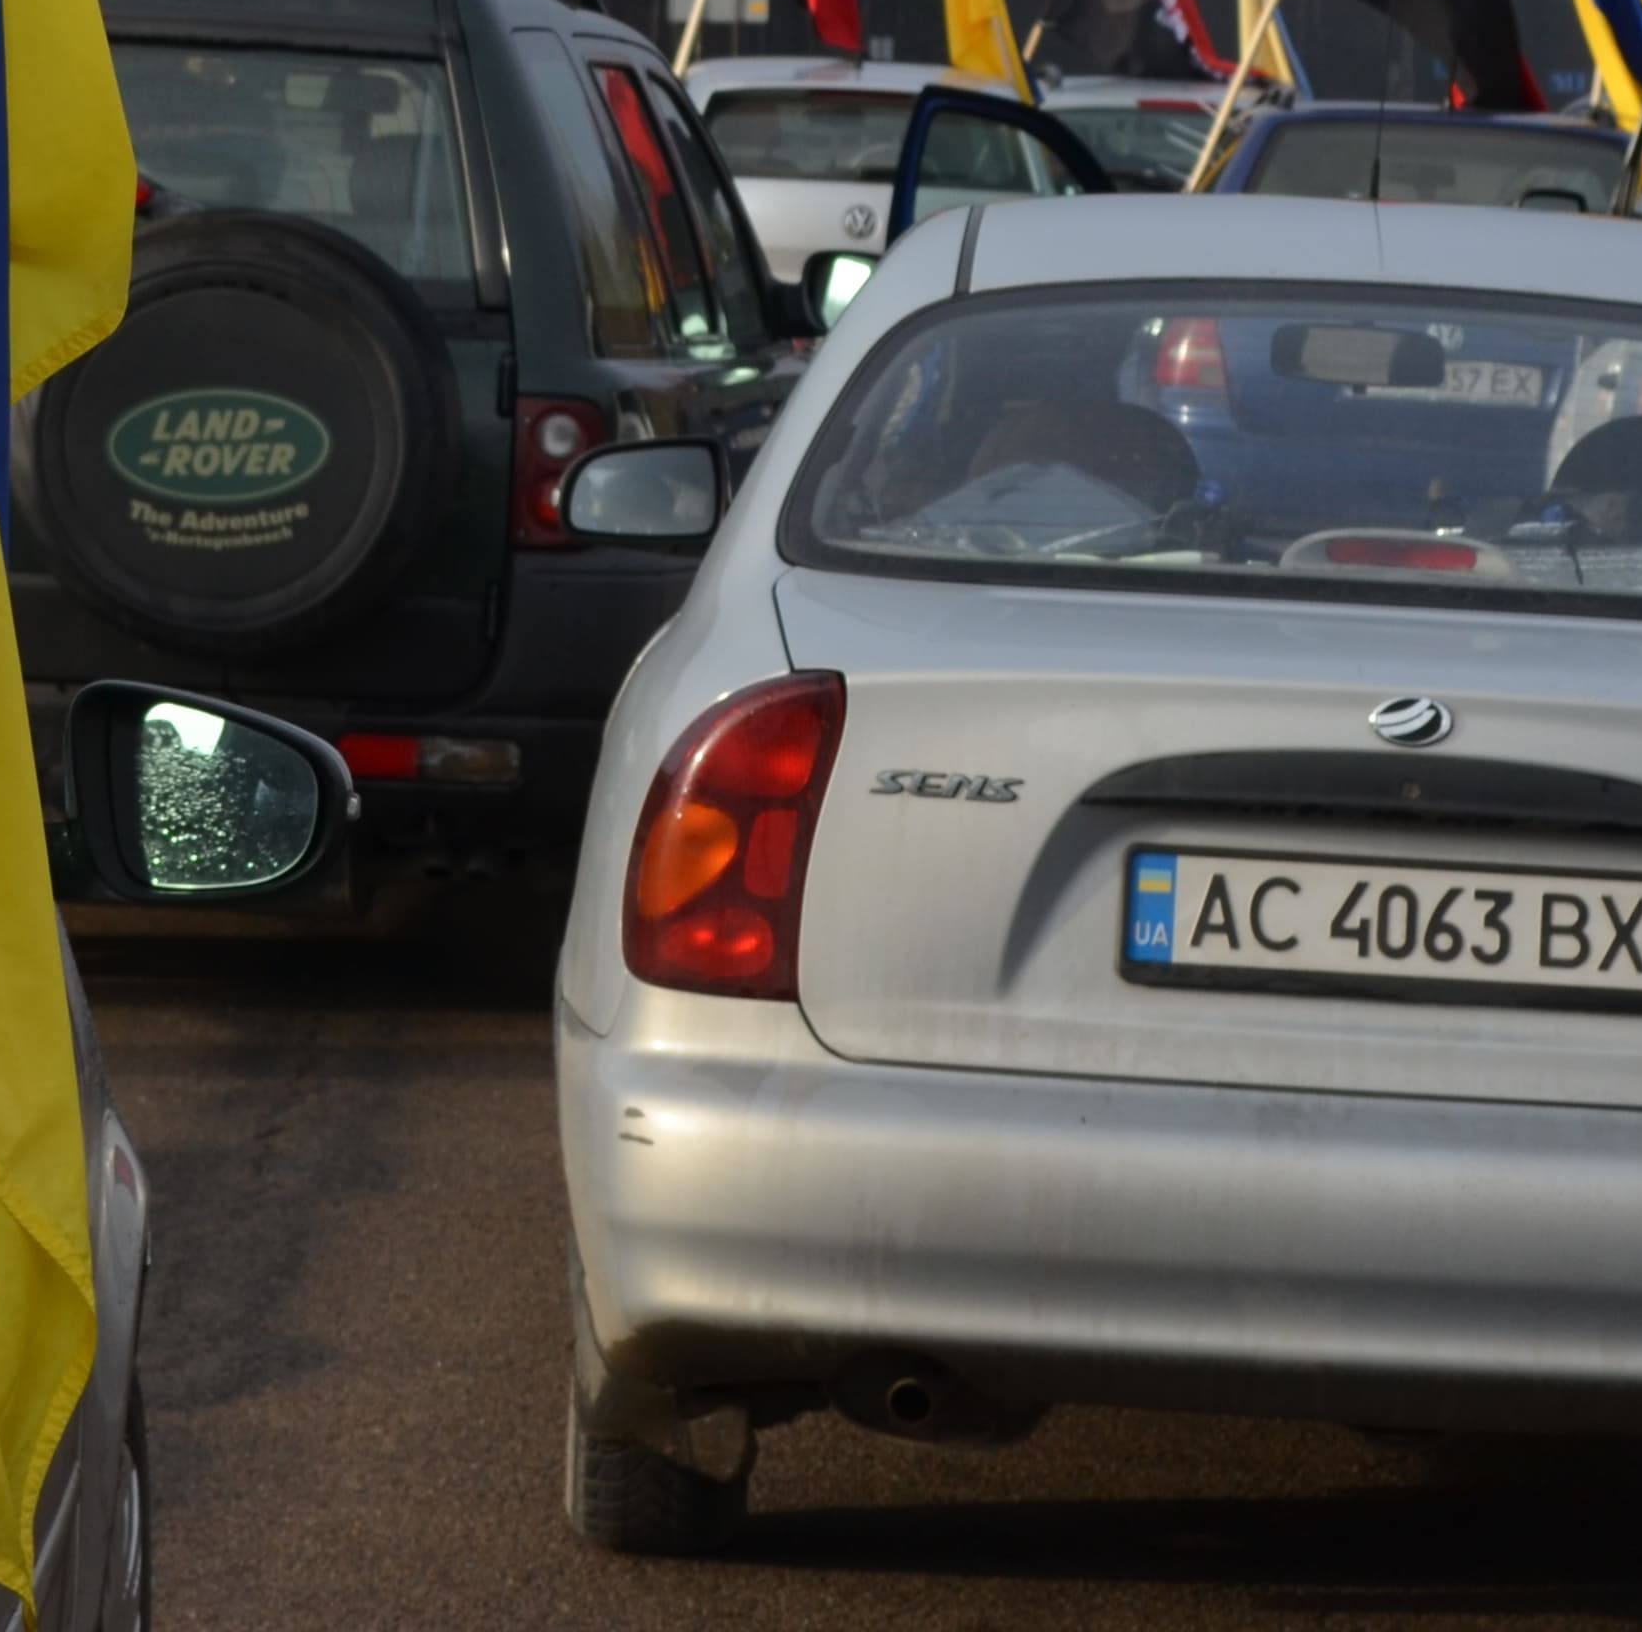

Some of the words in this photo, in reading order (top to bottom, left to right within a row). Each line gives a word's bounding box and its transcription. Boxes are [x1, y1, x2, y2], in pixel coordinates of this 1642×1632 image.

[153, 409, 259, 441] LAND
[163, 442, 297, 477] ROVER
[130, 499, 173, 527] The
[180, 503, 309, 531] Adventure
[868, 767, 1027, 803] SENS
[1134, 921, 1169, 948] UA
[1189, 872, 1302, 952] AC
[1329, 881, 1514, 966] 4063
